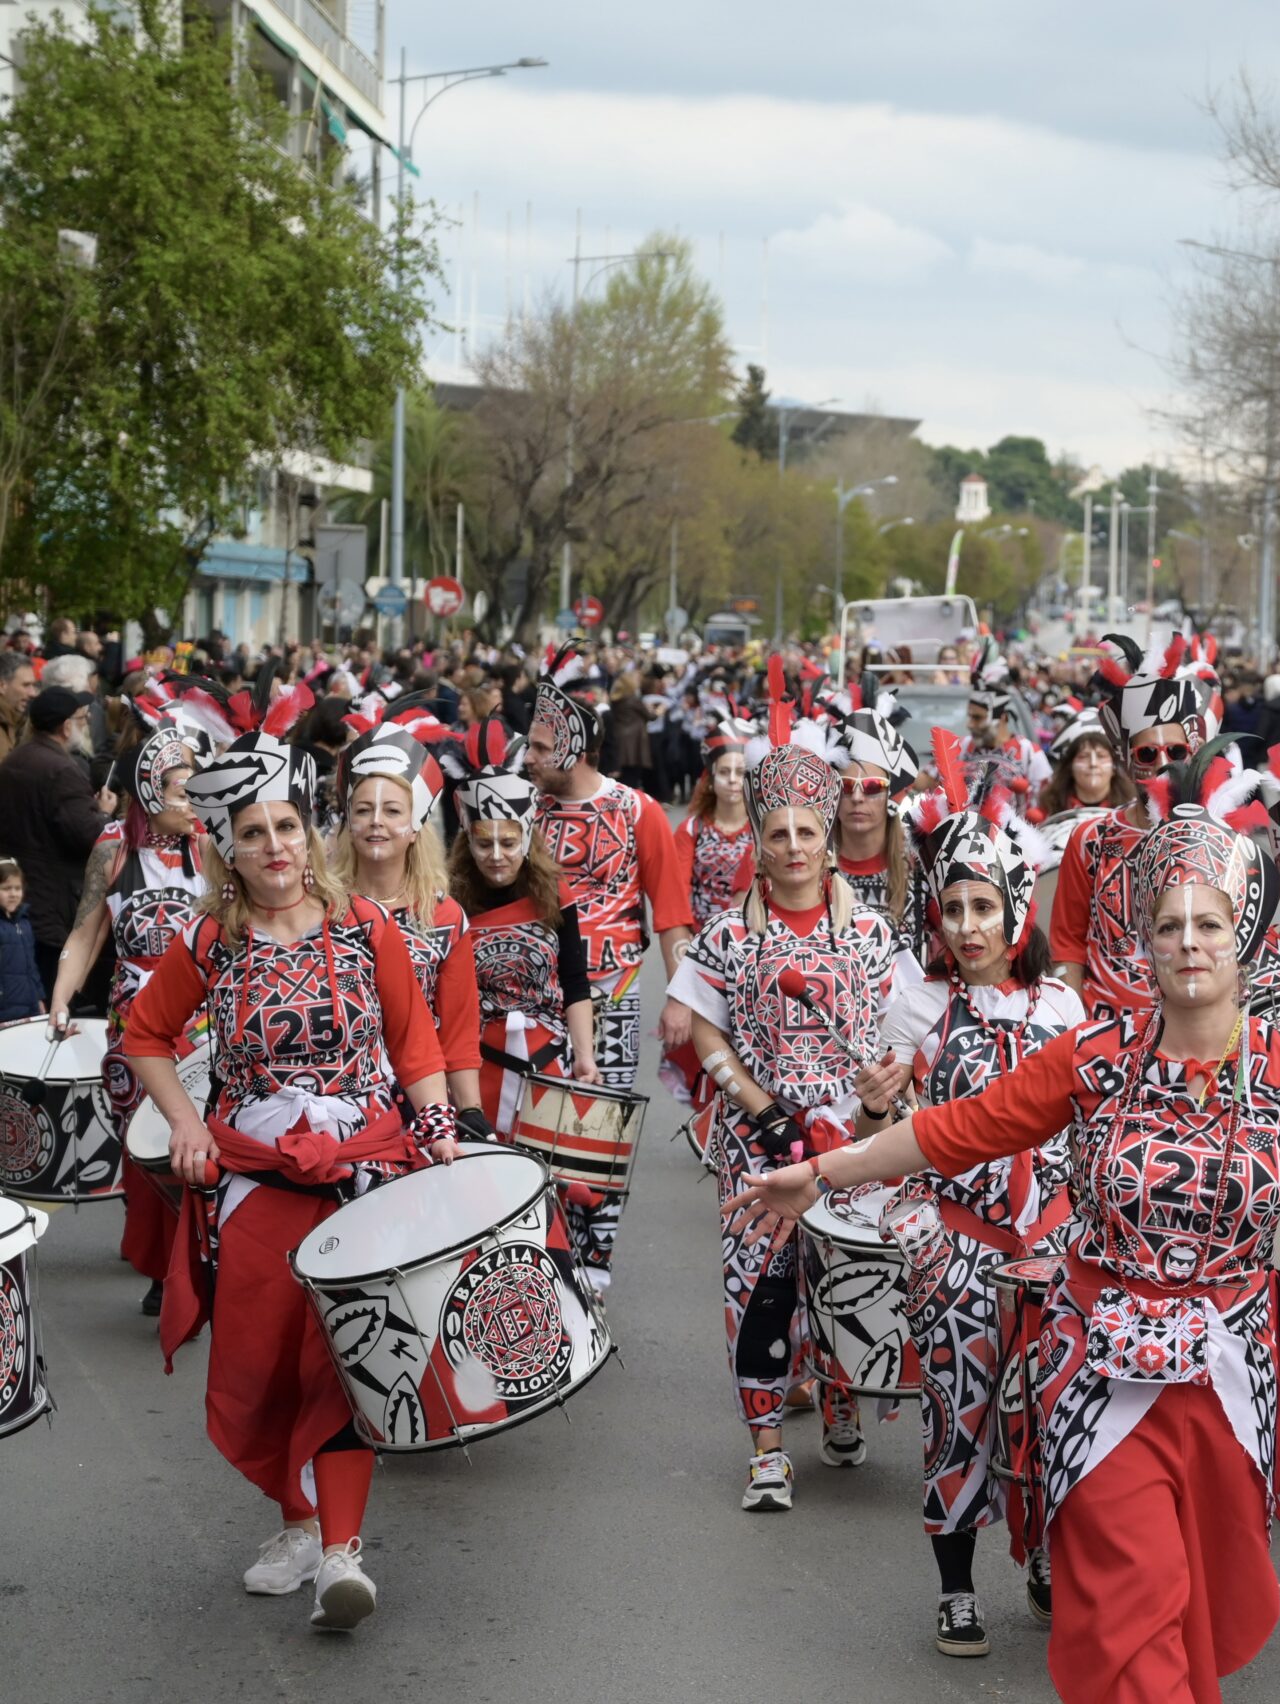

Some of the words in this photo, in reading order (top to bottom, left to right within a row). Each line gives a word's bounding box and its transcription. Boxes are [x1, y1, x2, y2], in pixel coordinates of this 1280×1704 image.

[1236, 881, 1260, 953] UNDO
[475, 943, 521, 967] RUPO
[266, 1004, 344, 1056] 25
[1149, 1148, 1246, 1216] 25
[453, 1247, 533, 1301] BATALA
[495, 1345, 571, 1395] SALONICA
